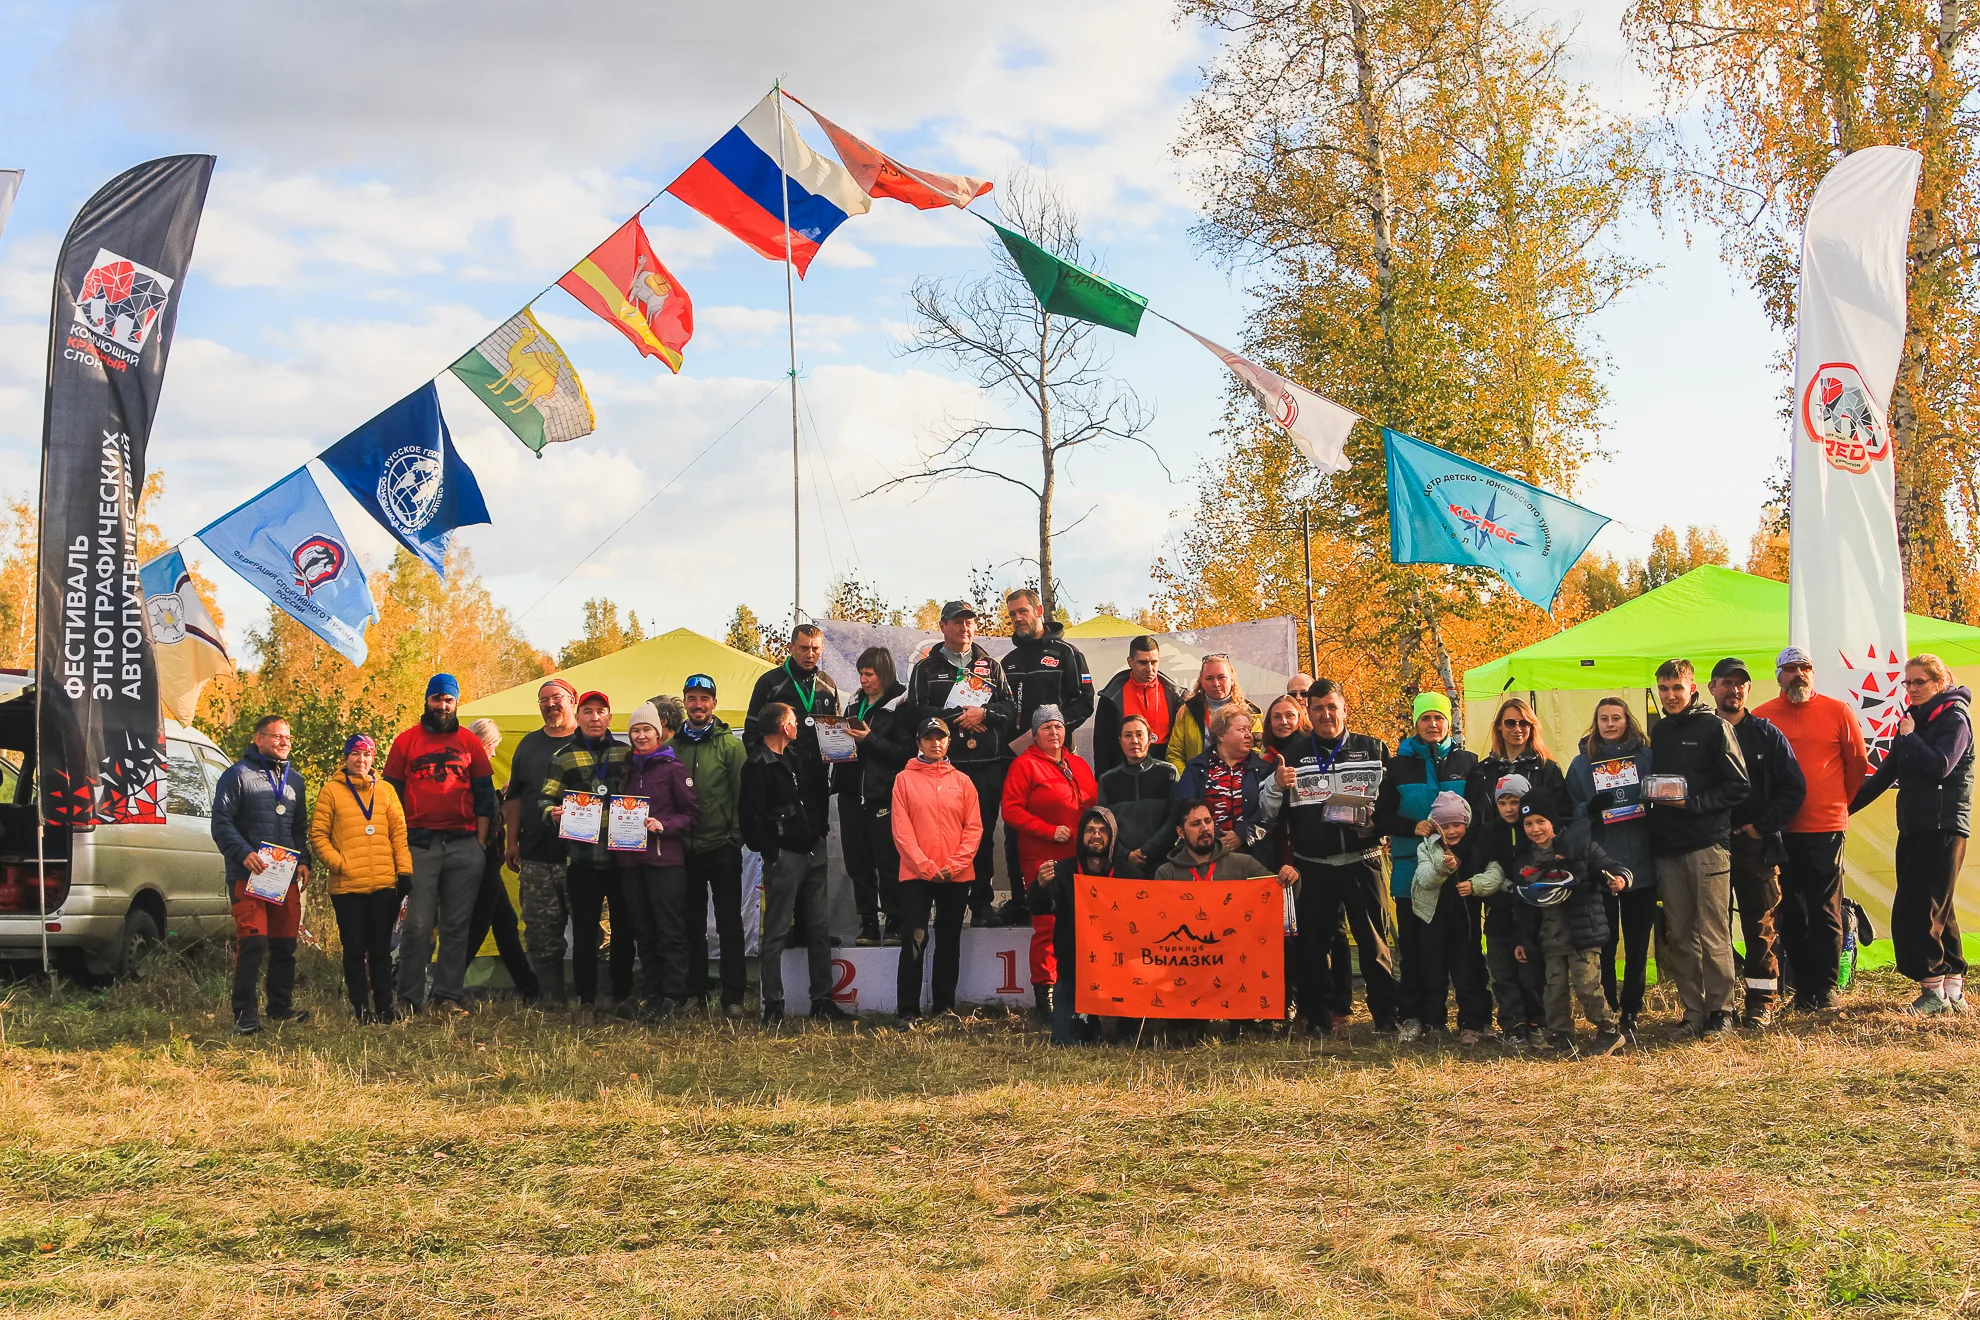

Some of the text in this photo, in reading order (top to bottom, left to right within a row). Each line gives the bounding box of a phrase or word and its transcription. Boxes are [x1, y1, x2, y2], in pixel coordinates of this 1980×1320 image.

[63, 348, 103, 371] СЛОН
[66, 336, 127, 373] КРАСНЫЙ
[70, 324, 139, 367] КОЧУЮЩИЙ
[384, 445, 421, 467] РУССКОЕ
[1825, 439, 1866, 461] RED
[1443, 473, 1477, 482] детско
[1485, 478, 1540, 518] юношеского
[1538, 517, 1552, 557] туризма
[1448, 503, 1518, 545] КОСМОС
[92, 429, 120, 700] ЭТНОГРАФИЧЕСКИХ
[121, 432, 142, 700] АВТОПУТЕШЕСТВИЙ
[233, 550, 354, 642] ФЕДЕРАЦИЯ СПОРТИВНОГО ТУРИЗМА
[275, 589, 306, 614] РОССИИ
[64, 535, 89, 699] ФЕСТИВАЛЬ
[1340, 771, 1376, 784] SPEED
[1140, 947, 1224, 967] Вылазки
[1158, 944, 1205, 953] турклуб
[831, 950, 1024, 1004] 2 1
